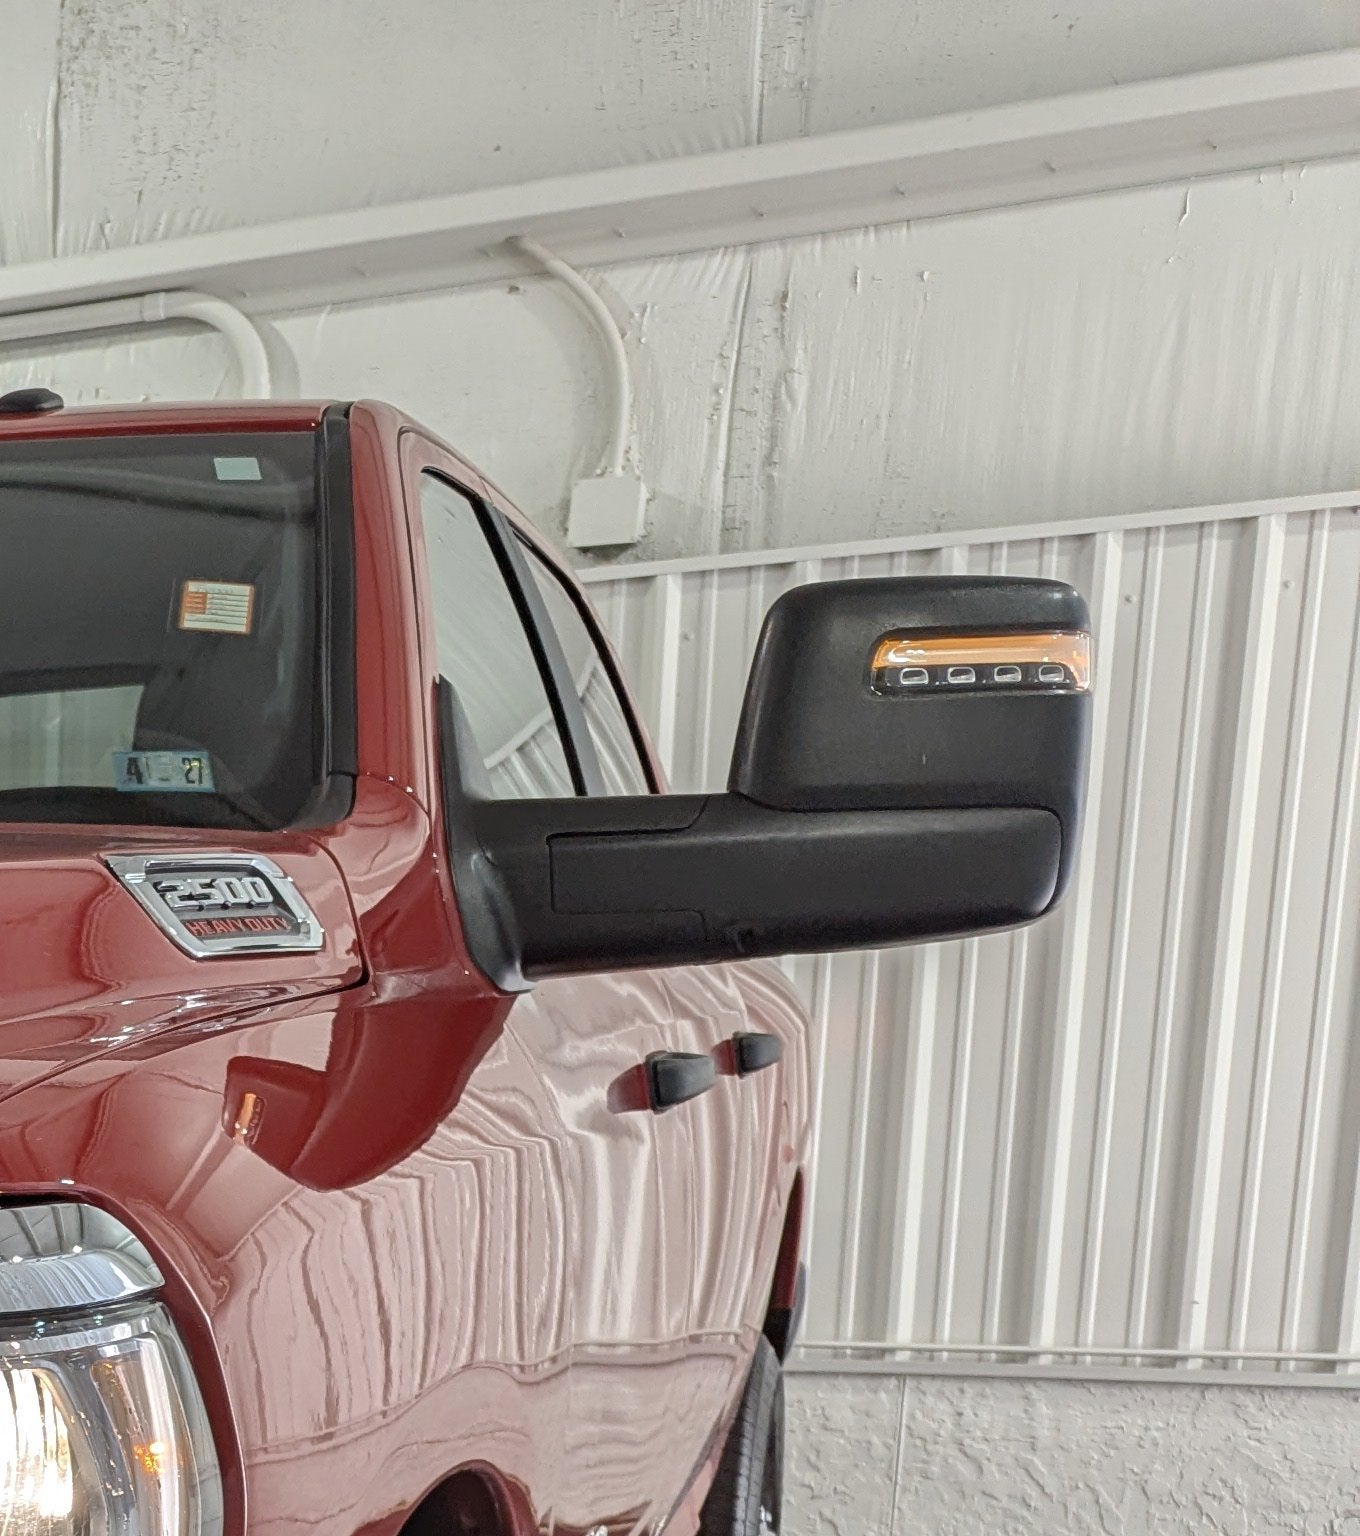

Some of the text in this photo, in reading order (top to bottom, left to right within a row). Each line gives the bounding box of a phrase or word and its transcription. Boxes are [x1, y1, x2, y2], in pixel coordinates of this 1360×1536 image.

[152, 876, 274, 912] 2500
[187, 916, 289, 935] HEAVY DUTY
